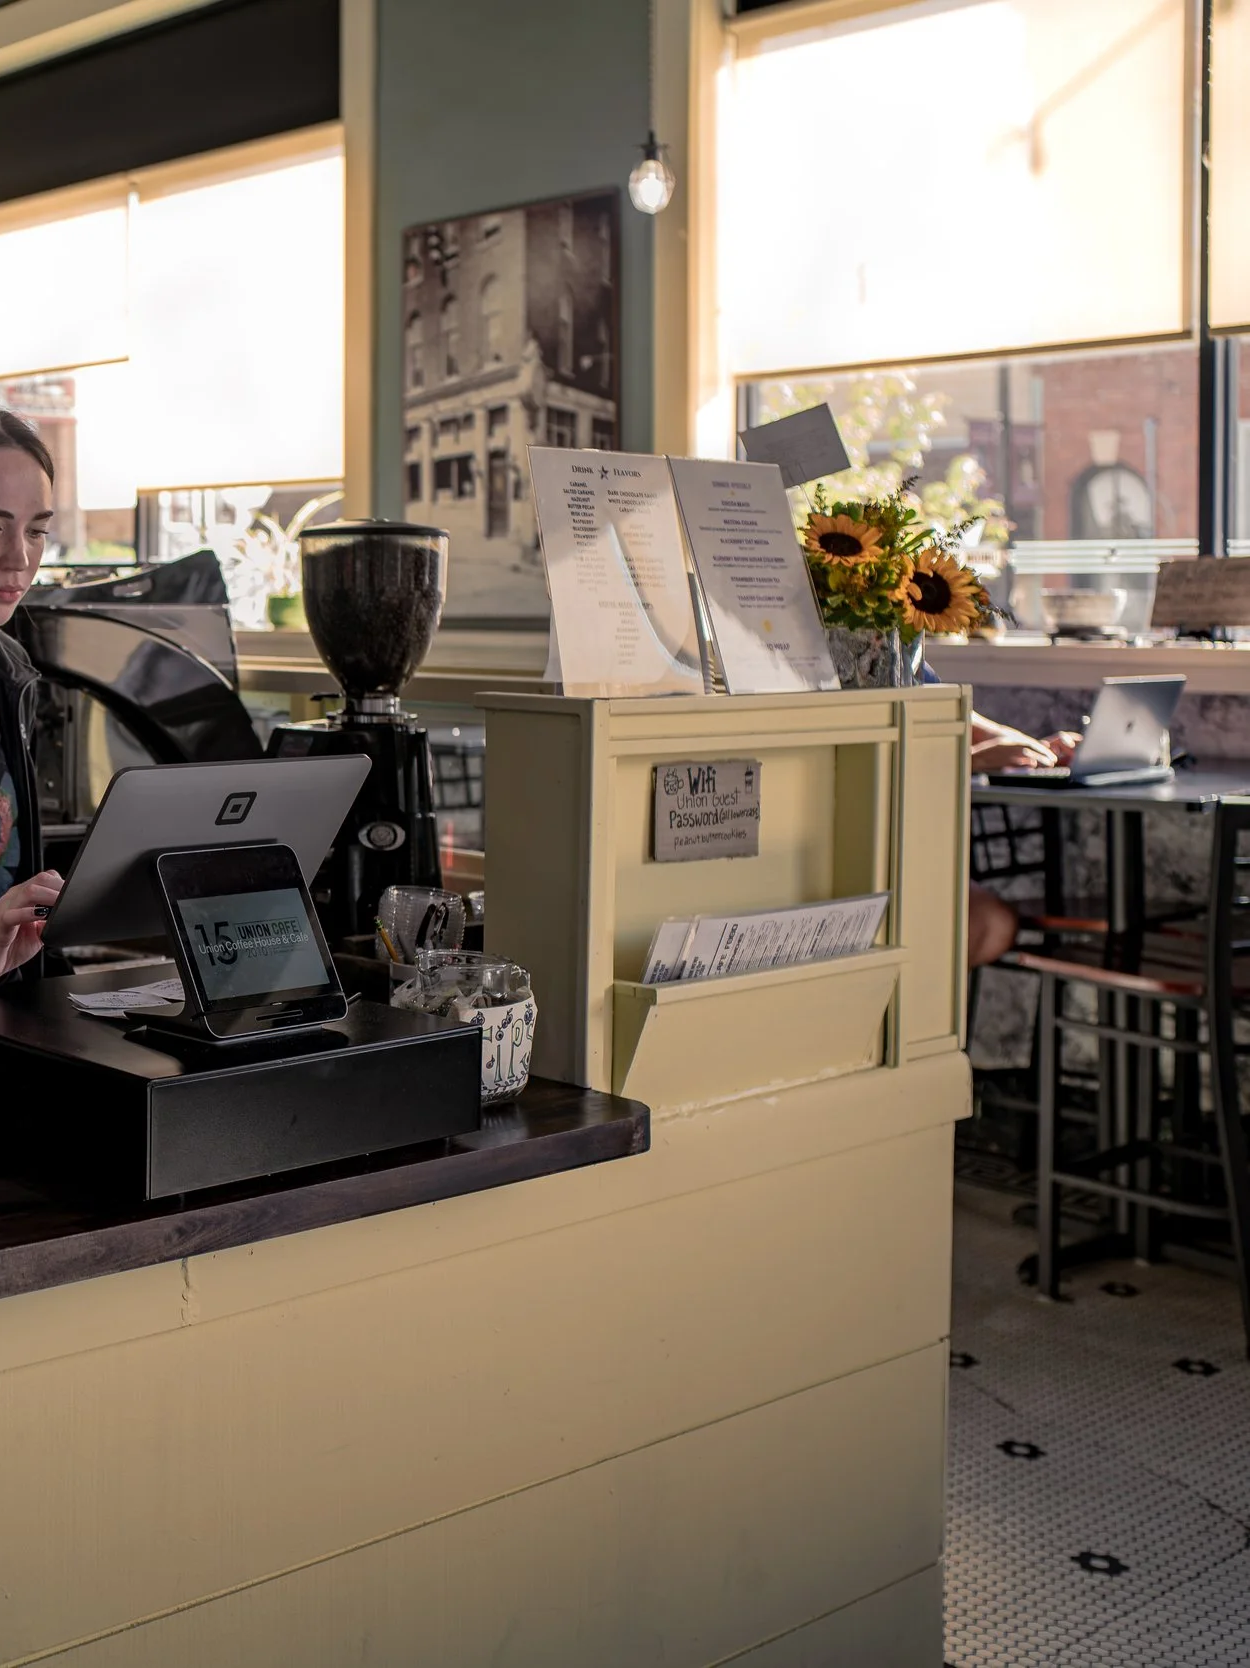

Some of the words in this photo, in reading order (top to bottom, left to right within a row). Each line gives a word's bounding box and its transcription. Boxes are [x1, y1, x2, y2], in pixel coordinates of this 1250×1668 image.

[676, 793, 708, 810] Union
[712, 786, 742, 807] Guest
[669, 808, 719, 829] Password
[237, 923, 271, 939] UNION
[271, 920, 299, 935] CAFE
[198, 942, 225, 954] Union
[225, 938, 253, 951] Coffee
[255, 936, 281, 947] House
[282, 935, 290, 944] &
